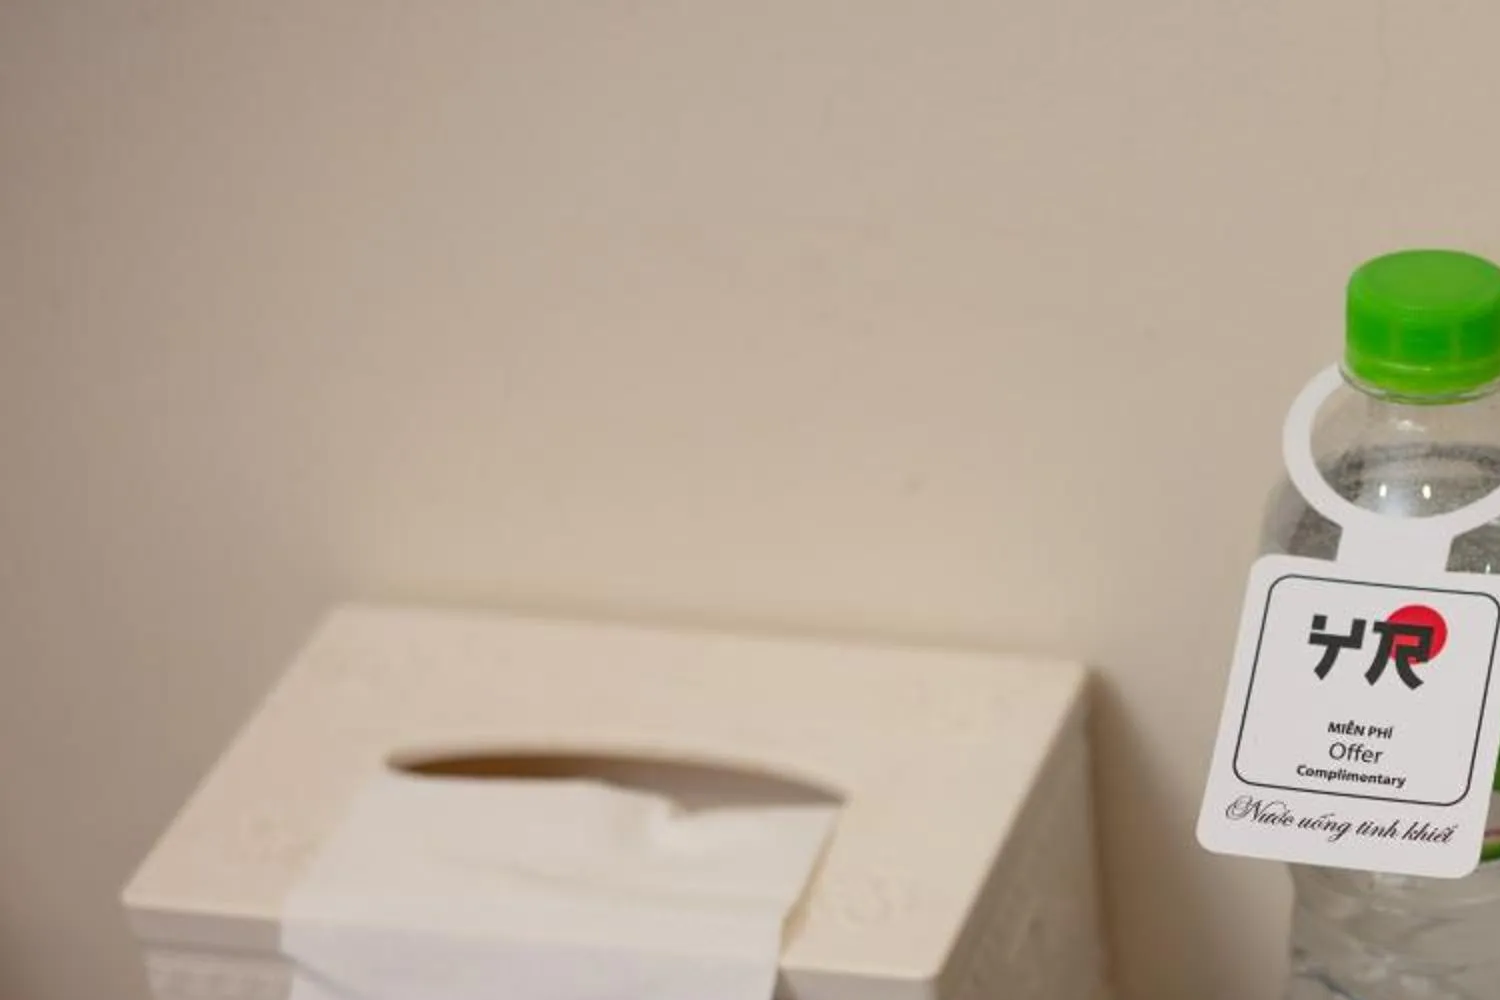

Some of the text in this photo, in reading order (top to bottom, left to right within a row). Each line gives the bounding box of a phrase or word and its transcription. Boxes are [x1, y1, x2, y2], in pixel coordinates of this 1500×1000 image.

[1367, 724, 1394, 739] PHÍ
[1329, 741, 1384, 764] Offer
[1296, 764, 1407, 789] Complimentary
